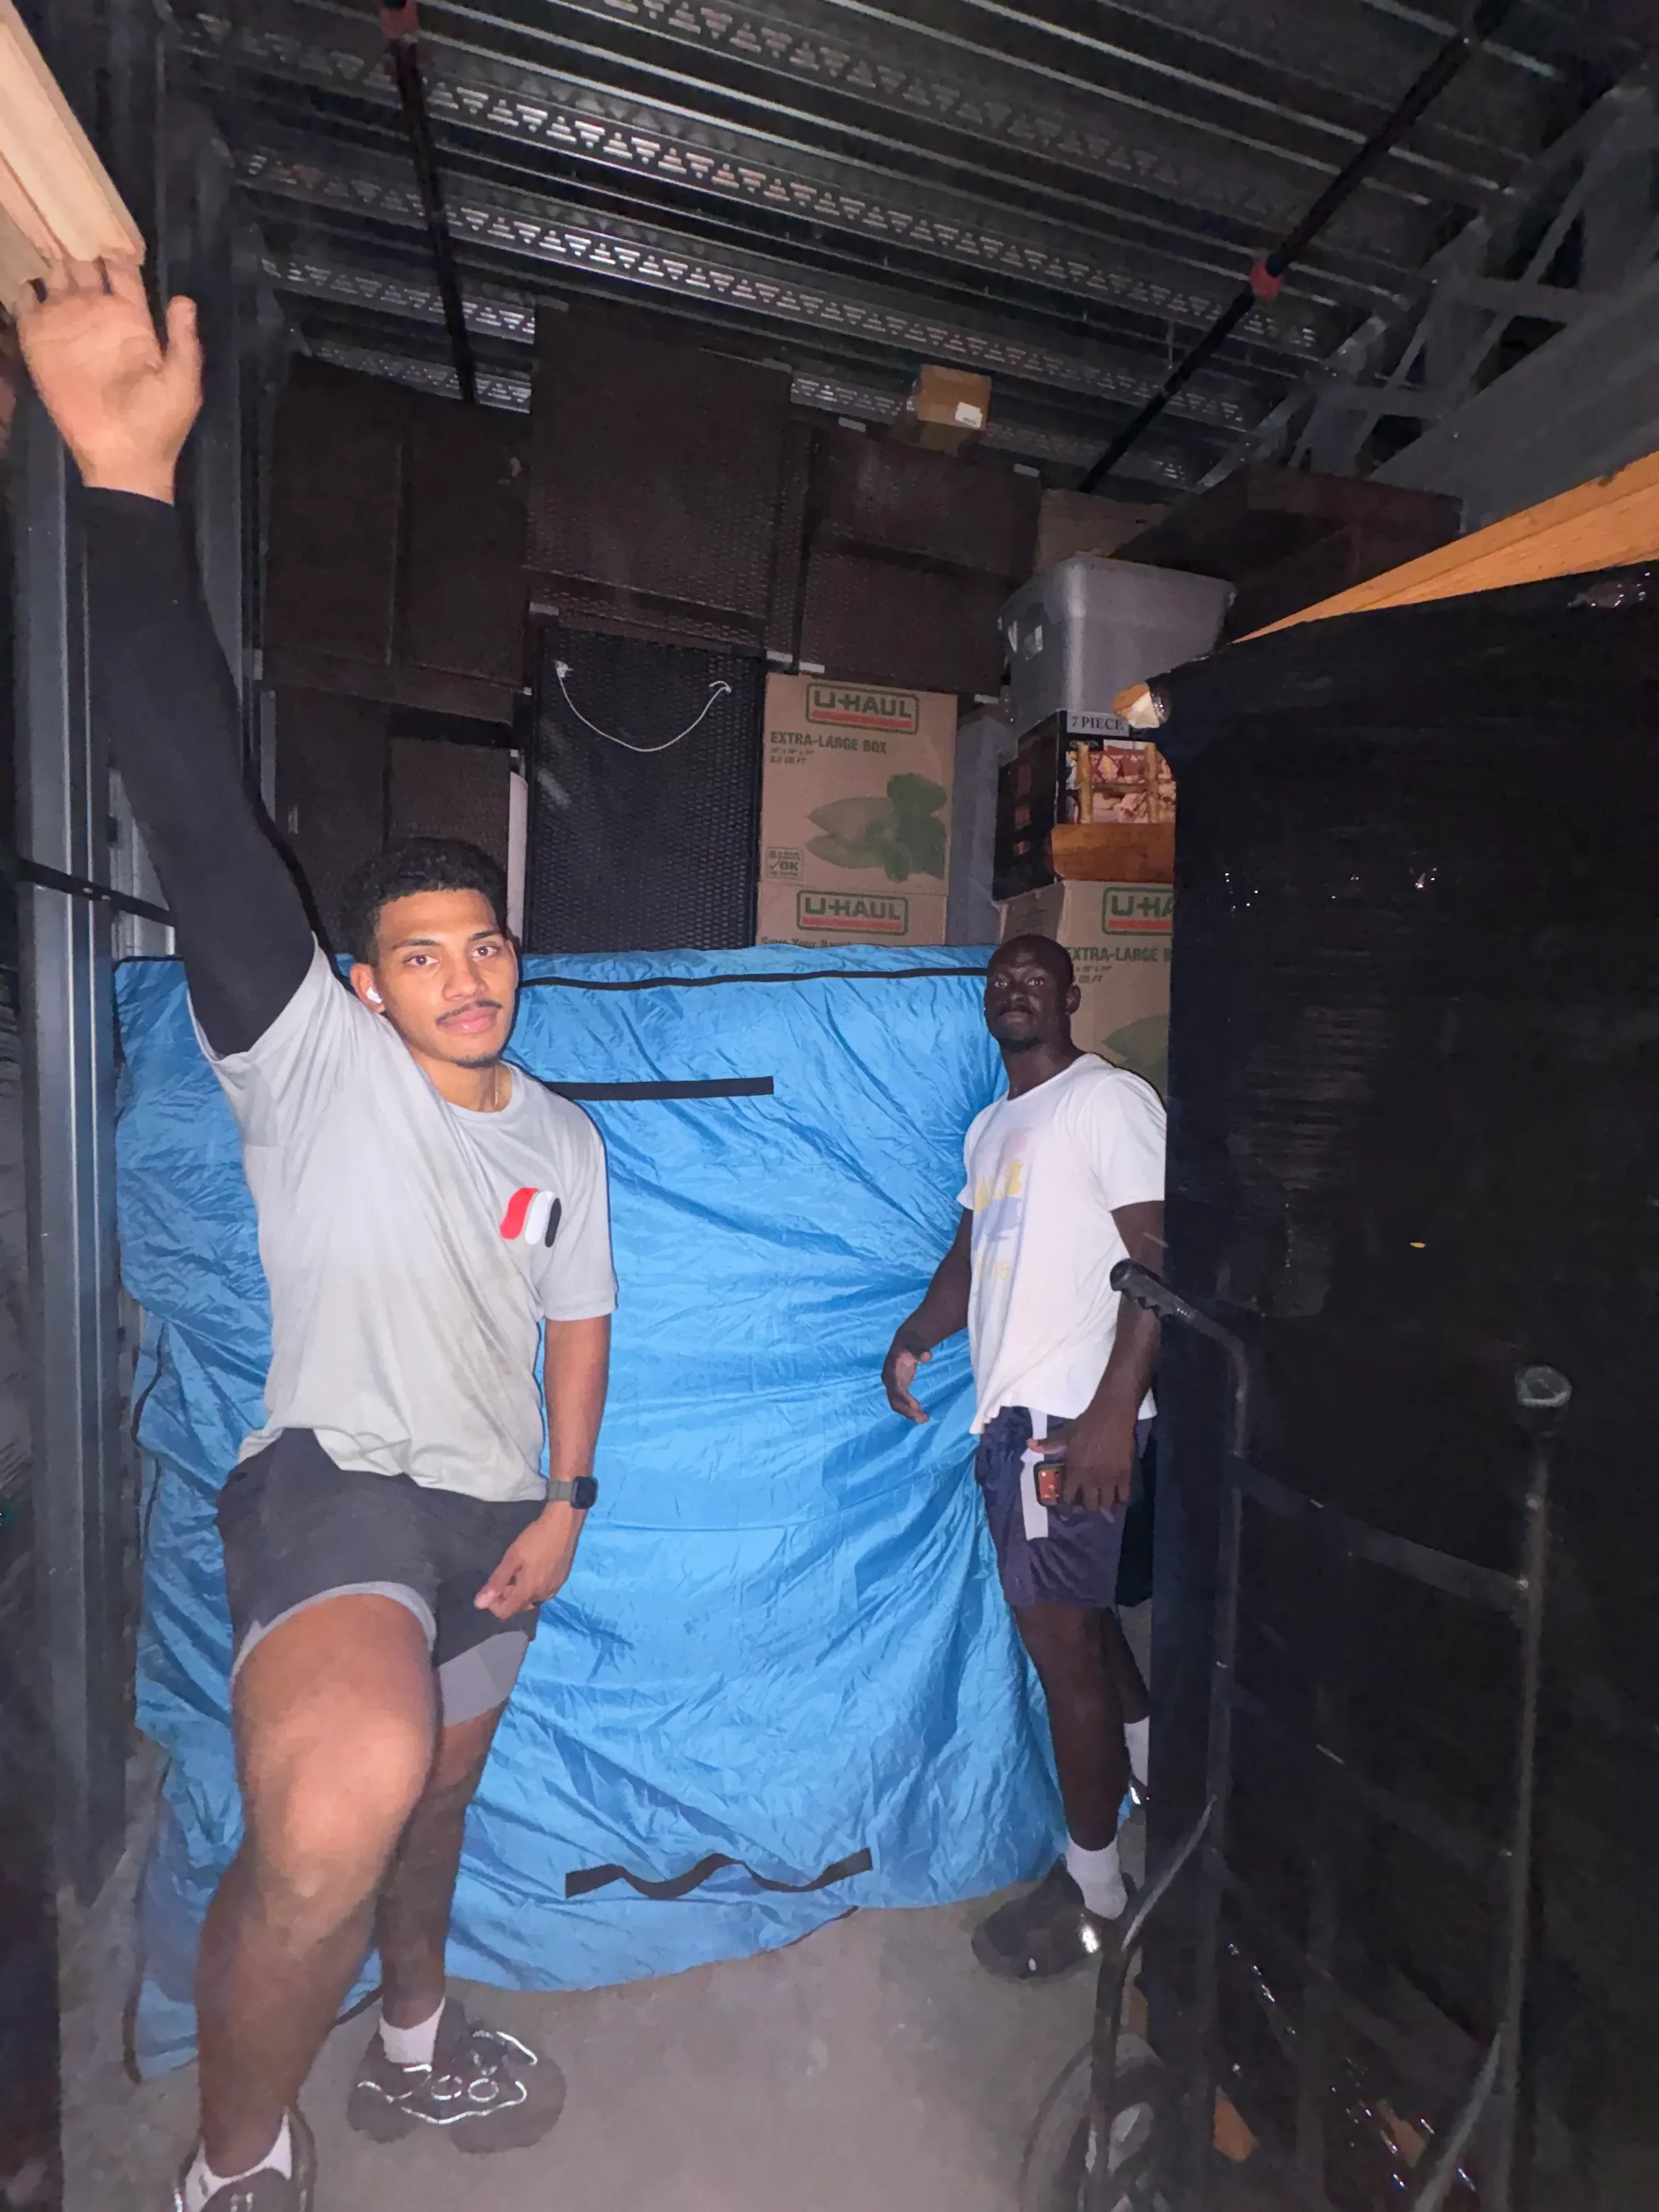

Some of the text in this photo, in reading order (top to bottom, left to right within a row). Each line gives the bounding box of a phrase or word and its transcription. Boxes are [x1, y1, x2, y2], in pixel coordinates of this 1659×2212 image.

[1071, 716, 1124, 730] 7 PIECE
[770, 731, 859, 751] EXTRA-LARGE
[863, 740, 888, 754] BOX
[1111, 895, 1173, 917] U-HA
[1064, 947, 1158, 962] XTRA-LARGE
